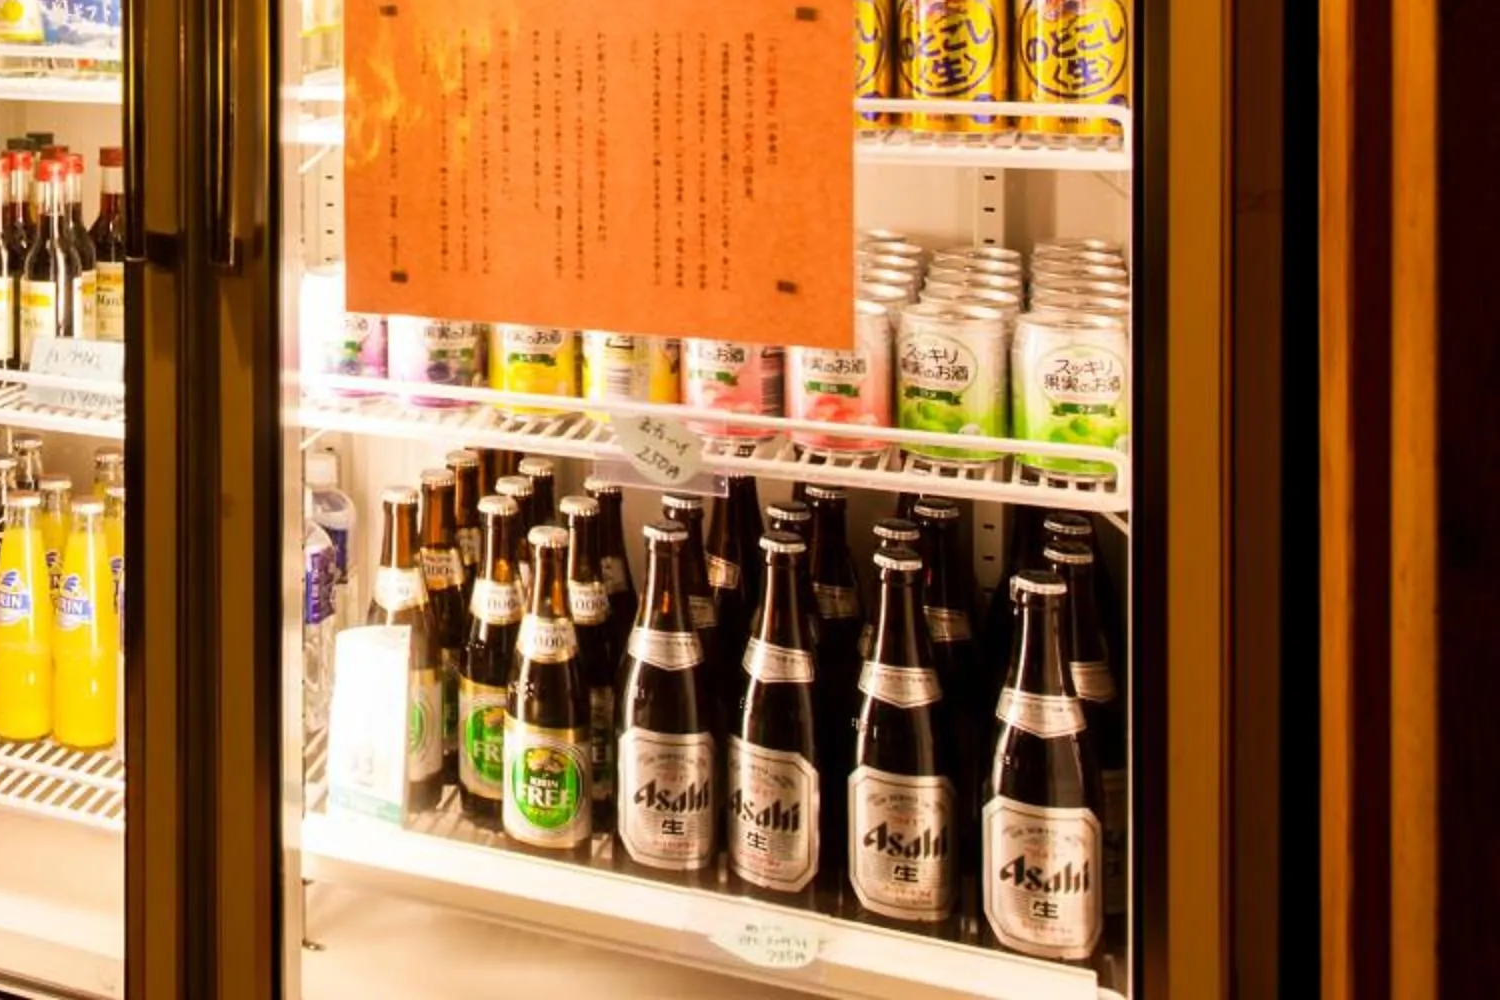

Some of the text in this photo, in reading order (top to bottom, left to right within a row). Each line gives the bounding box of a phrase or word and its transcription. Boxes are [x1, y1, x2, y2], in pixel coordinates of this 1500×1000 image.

[901, 16, 992, 63] のどこし
[1025, 18, 1125, 64] のどこし
[906, 342, 960, 364] スッキリ
[1054, 357, 1114, 377] スッキリ
[1044, 373, 1121, 393] 果実のお酒
[517, 786, 572, 807] FREE
[633, 778, 710, 813] Asahi
[729, 788, 801, 833] Asahi
[660, 818, 685, 836] 生
[746, 831, 768, 851] 生
[863, 820, 949, 860] Asahi
[892, 865, 919, 884] 生
[999, 854, 1090, 895] Asahi
[1031, 901, 1060, 920] 生
